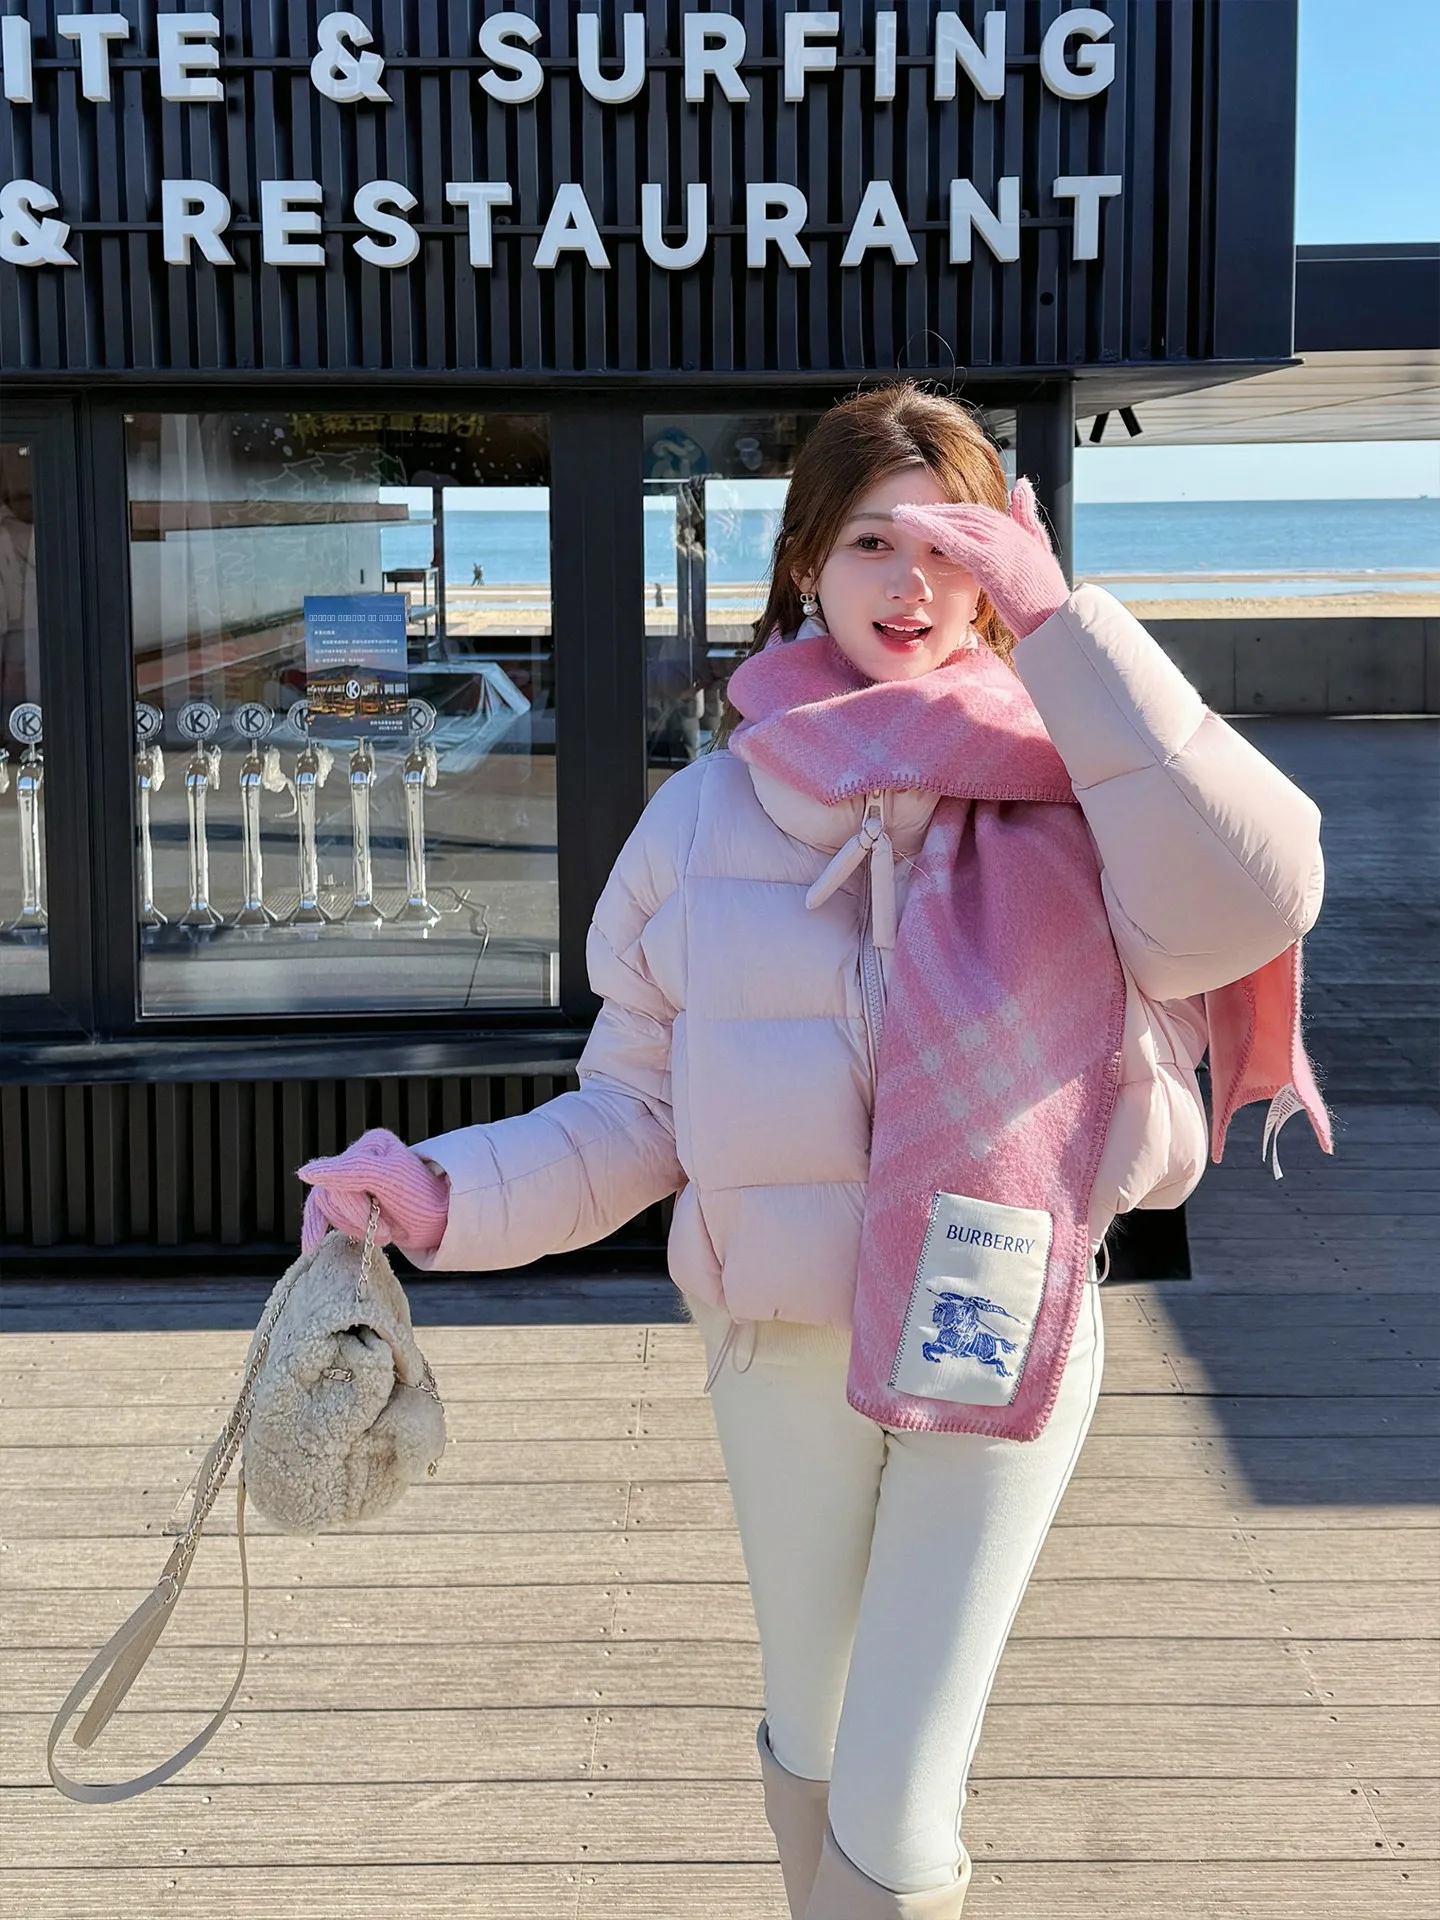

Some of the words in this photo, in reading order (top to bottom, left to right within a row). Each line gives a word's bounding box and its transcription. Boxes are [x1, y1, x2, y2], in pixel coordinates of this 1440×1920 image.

[310, 11, 394, 104] &
[477, 8, 1116, 105] SURFING
[0, 179, 79, 267] &
[161, 175, 1123, 271] RESTAURANT
[946, 1224, 1036, 1255] BURBERRY
